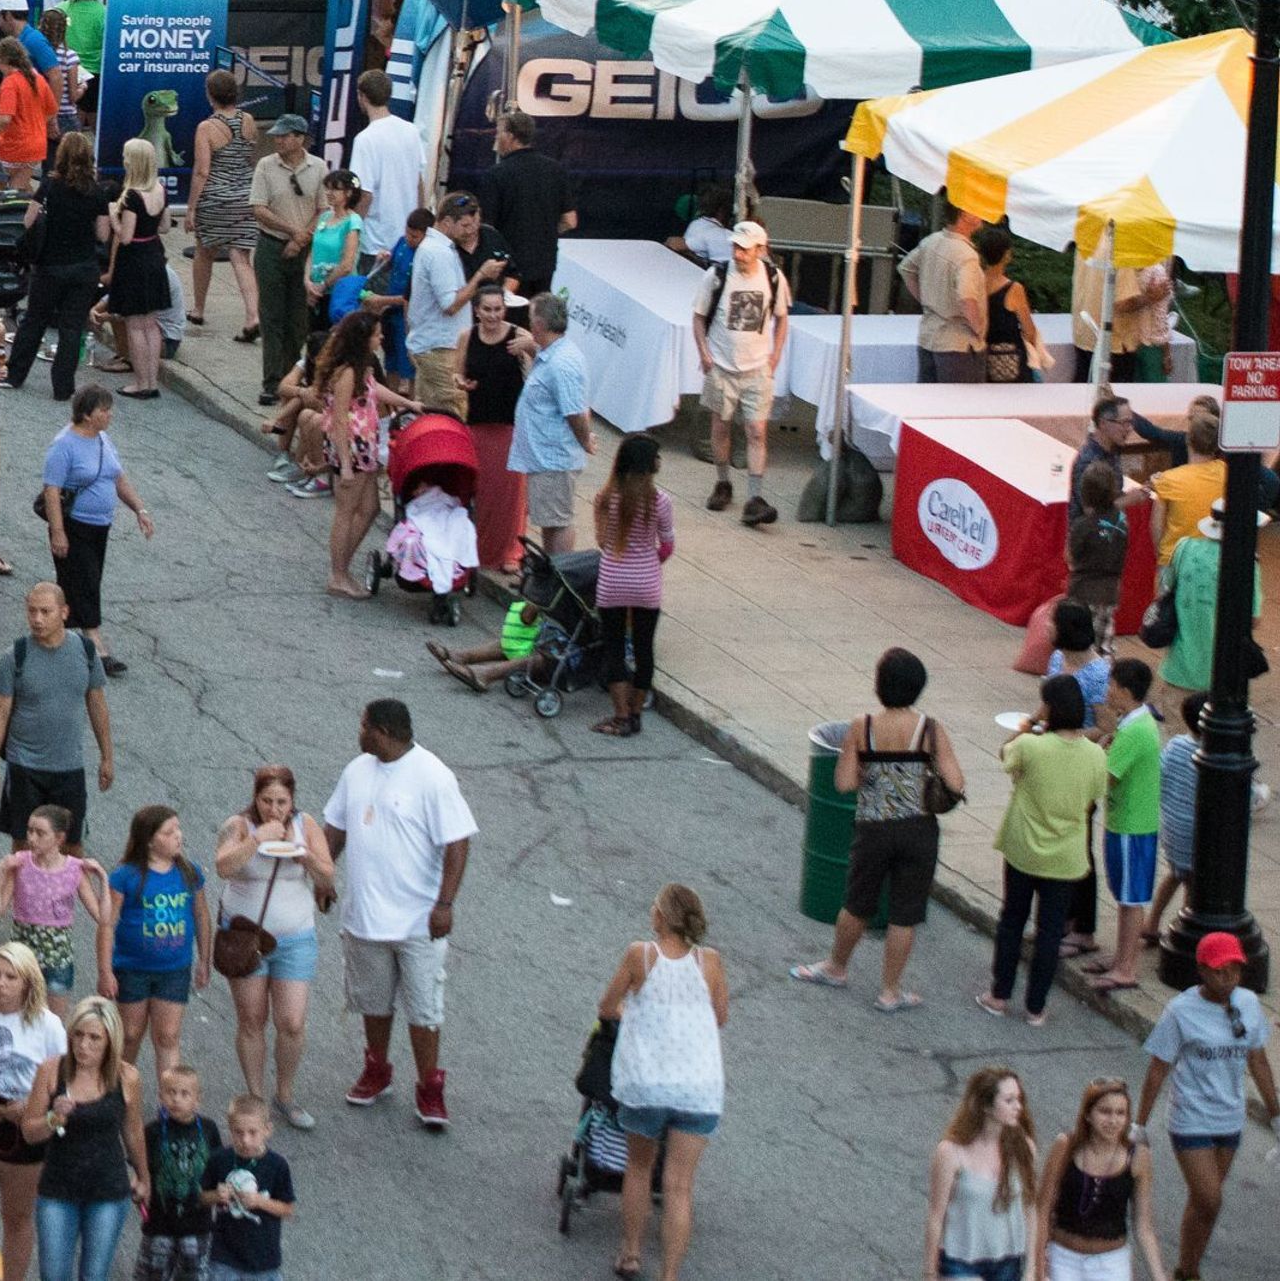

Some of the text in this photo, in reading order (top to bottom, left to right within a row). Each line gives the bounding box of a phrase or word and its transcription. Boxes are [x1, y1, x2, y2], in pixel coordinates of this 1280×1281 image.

[122, 15, 212, 28] Saving people
[120, 29, 211, 48] MONEY
[119, 50, 210, 62] on more than just
[119, 61, 210, 73] car insurance
[596, 312, 627, 349] Health
[1229, 358, 1251, 370] TOW
[1246, 371, 1263, 384] NO
[1231, 385, 1278, 398] PARKING
[927, 519, 983, 560] URGENT CARE
[143, 892, 188, 909] LOVE
[143, 920, 186, 938] LOVE
